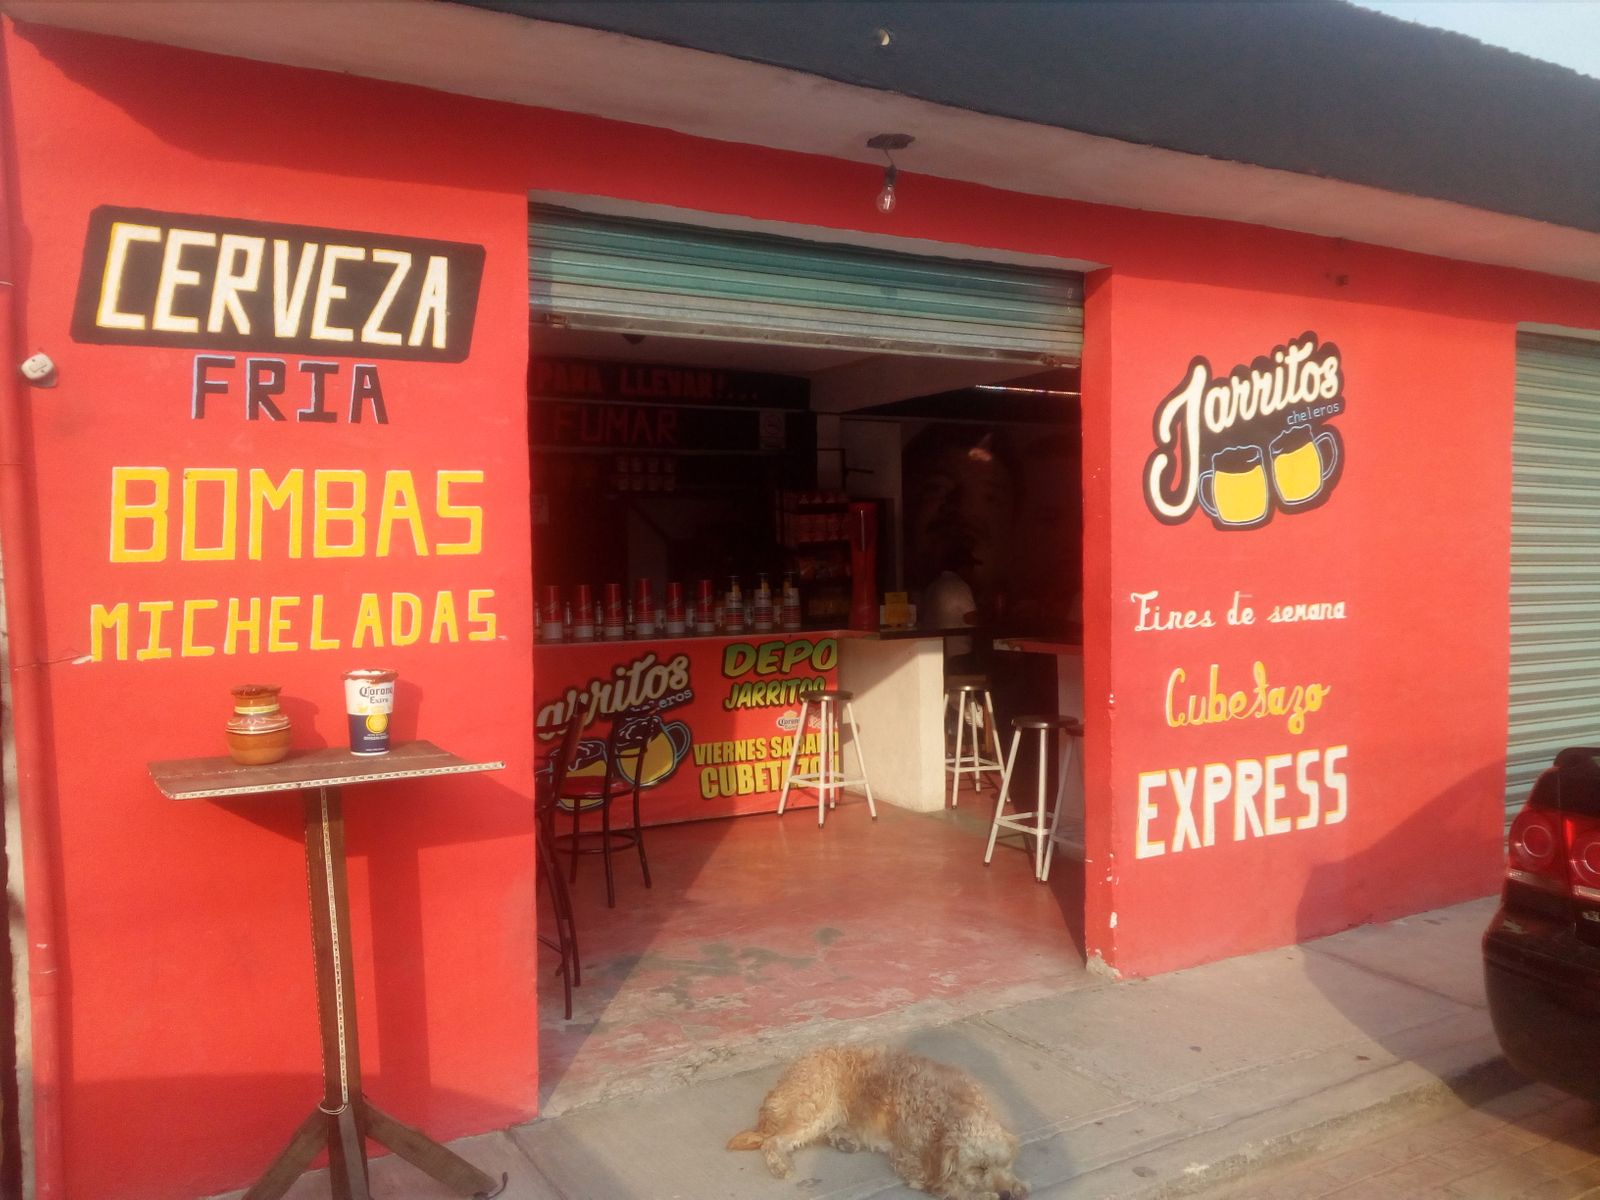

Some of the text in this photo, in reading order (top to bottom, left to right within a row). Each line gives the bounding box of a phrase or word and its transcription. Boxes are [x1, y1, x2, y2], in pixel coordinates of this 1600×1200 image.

[96, 222, 449, 349] CERVEZA
[191, 354, 389, 425] FRIA
[555, 404, 678, 444] FUMAR
[1286, 402, 1340, 425] cheleros
[1150, 341, 1339, 517] Jarritos
[110, 467, 484, 563] BOMBAS
[91, 589, 496, 662] MICHELADAS
[1131, 590, 1348, 632] Fines de semana
[724, 639, 838, 677] DEPO
[536, 654, 689, 740] arritos
[1166, 661, 1331, 735] Cubetazo
[694, 737, 767, 765] VIERNES
[1136, 745, 1348, 859] EXPRESS
